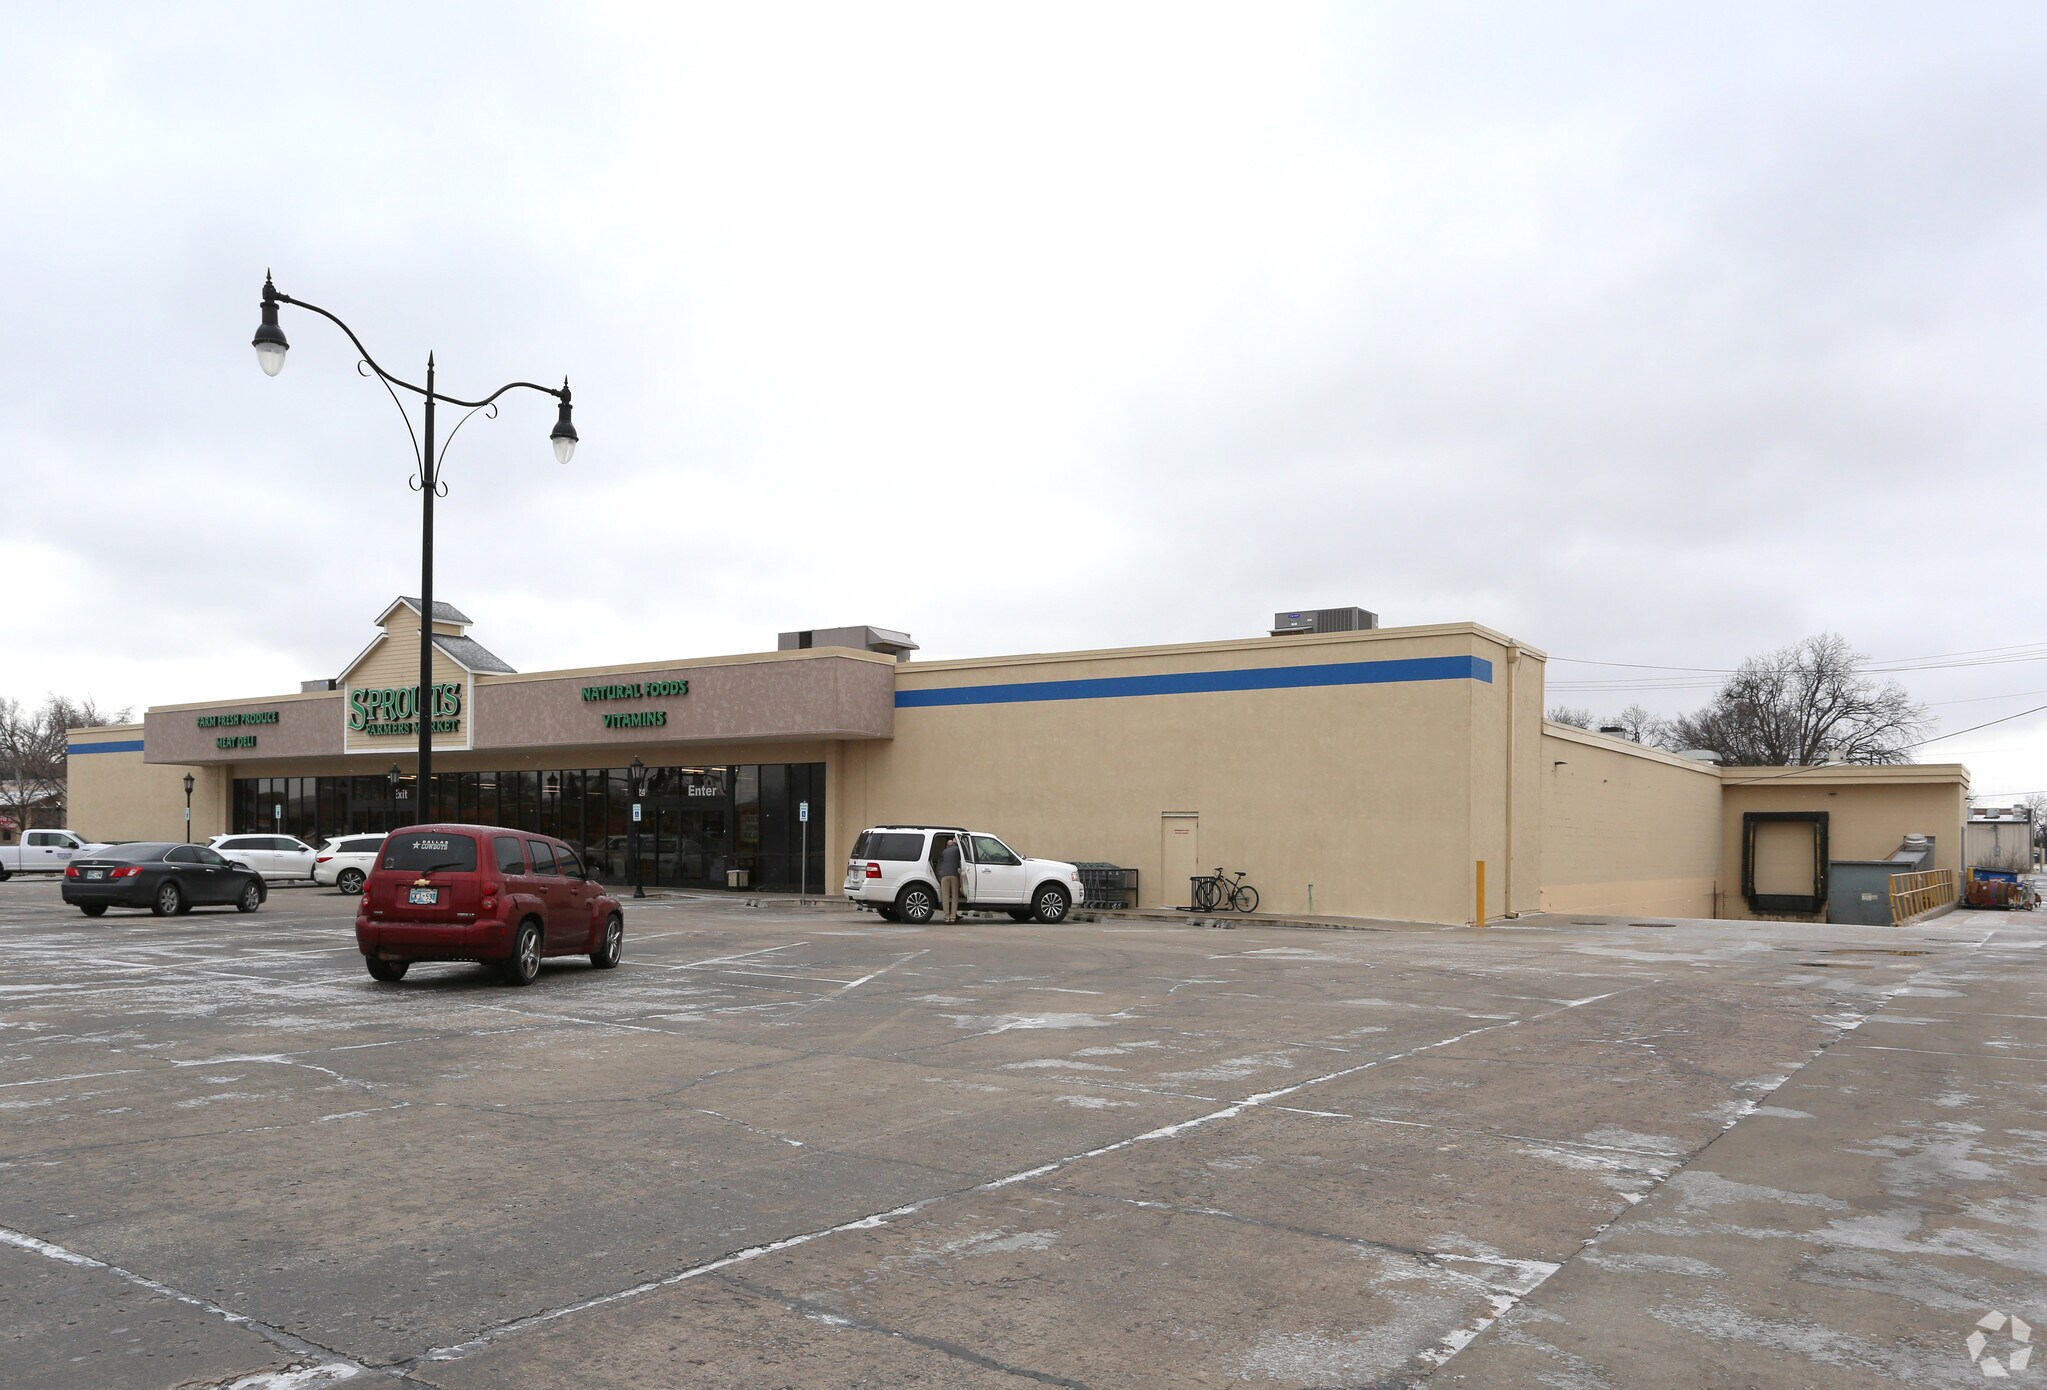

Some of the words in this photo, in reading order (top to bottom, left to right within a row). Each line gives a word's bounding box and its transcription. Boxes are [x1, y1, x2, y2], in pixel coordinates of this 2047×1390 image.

[582, 683, 642, 700] NATURAL
[643, 680, 687, 697] FOODS
[197, 716, 217, 728] FARM
[218, 714, 240, 726] FRESH
[241, 712, 278, 725] PRODUCE
[366, 722, 411, 735] FARMERS
[412, 719, 459, 733] MRKET
[603, 711, 666, 727] VITAMINS
[217, 737, 237, 749] MEAT
[237, 735, 256, 748] DELI
[688, 785, 717, 797] Enter
